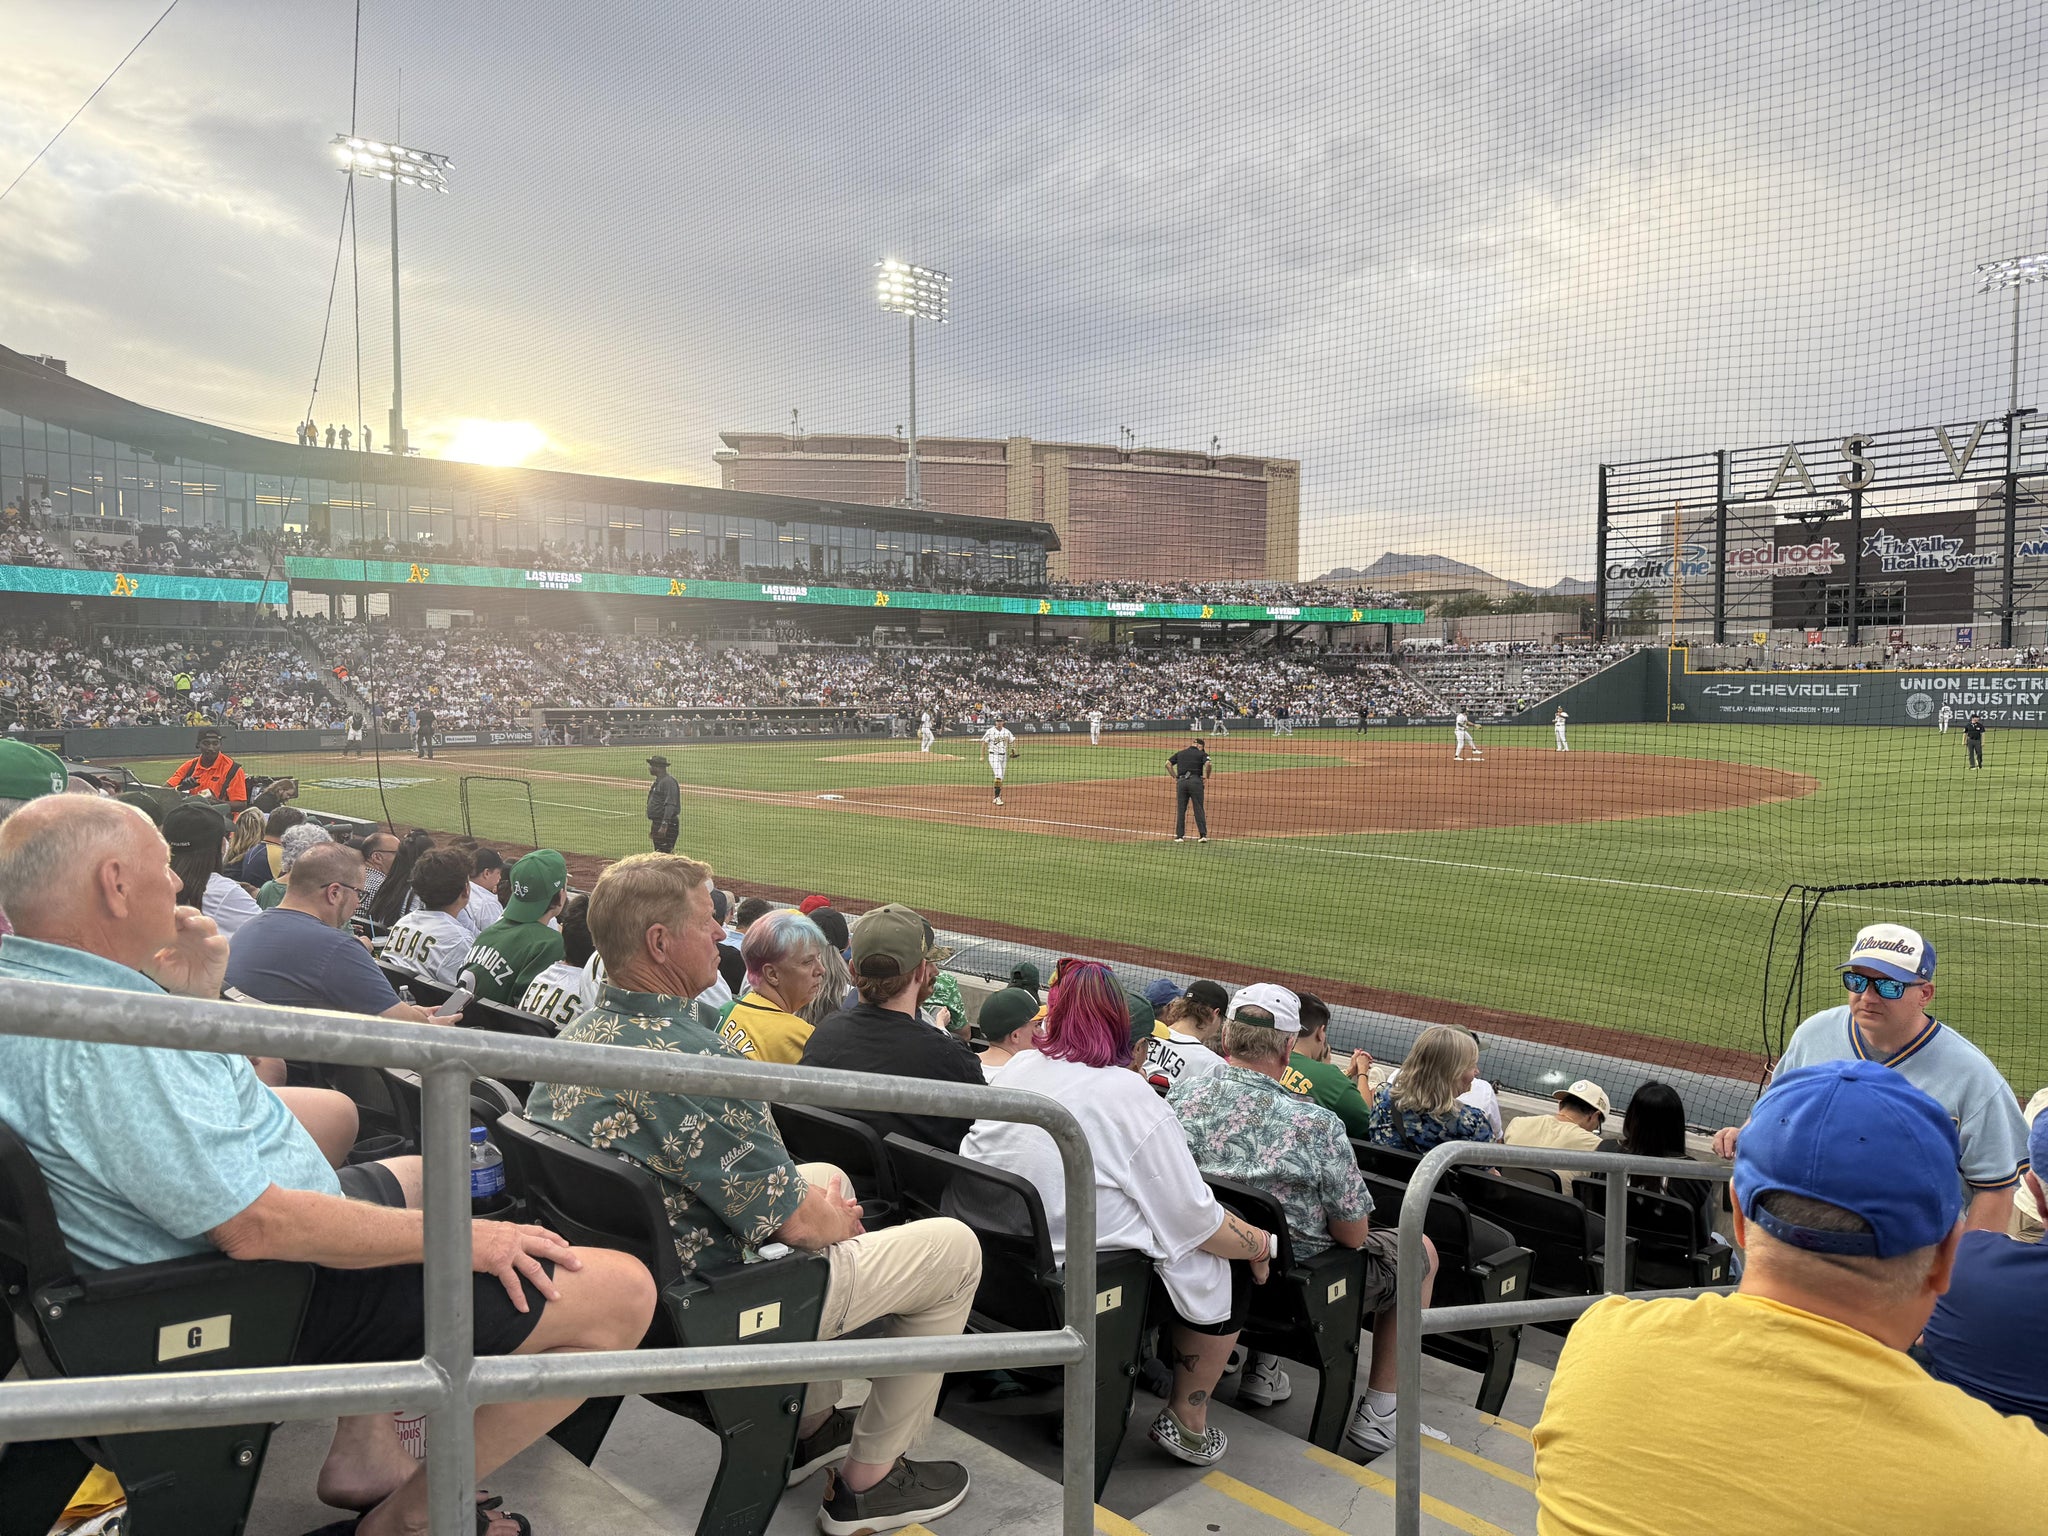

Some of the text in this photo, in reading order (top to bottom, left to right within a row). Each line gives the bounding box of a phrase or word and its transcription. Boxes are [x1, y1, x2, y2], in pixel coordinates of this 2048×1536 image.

[1722, 433, 1875, 499] LAS
[1729, 538, 1840, 566] red rock
[525, 570, 582, 583] LAS VEGAS
[1736, 565, 1831, 577] CASINO RESORT SPA
[762, 585, 807, 596] LAS VEGAS
[1750, 684, 1859, 696] CHEVROLET
[1900, 678, 1960, 690] UNION
[1943, 692, 2043, 705] INDUSTRY
[513, 880, 529, 897] A's
[1853, 936, 1916, 956] Milwaukee
[1106, 1293, 1112, 1307] E
[756, 1312, 764, 1328] F
[187, 1326, 203, 1349] G
